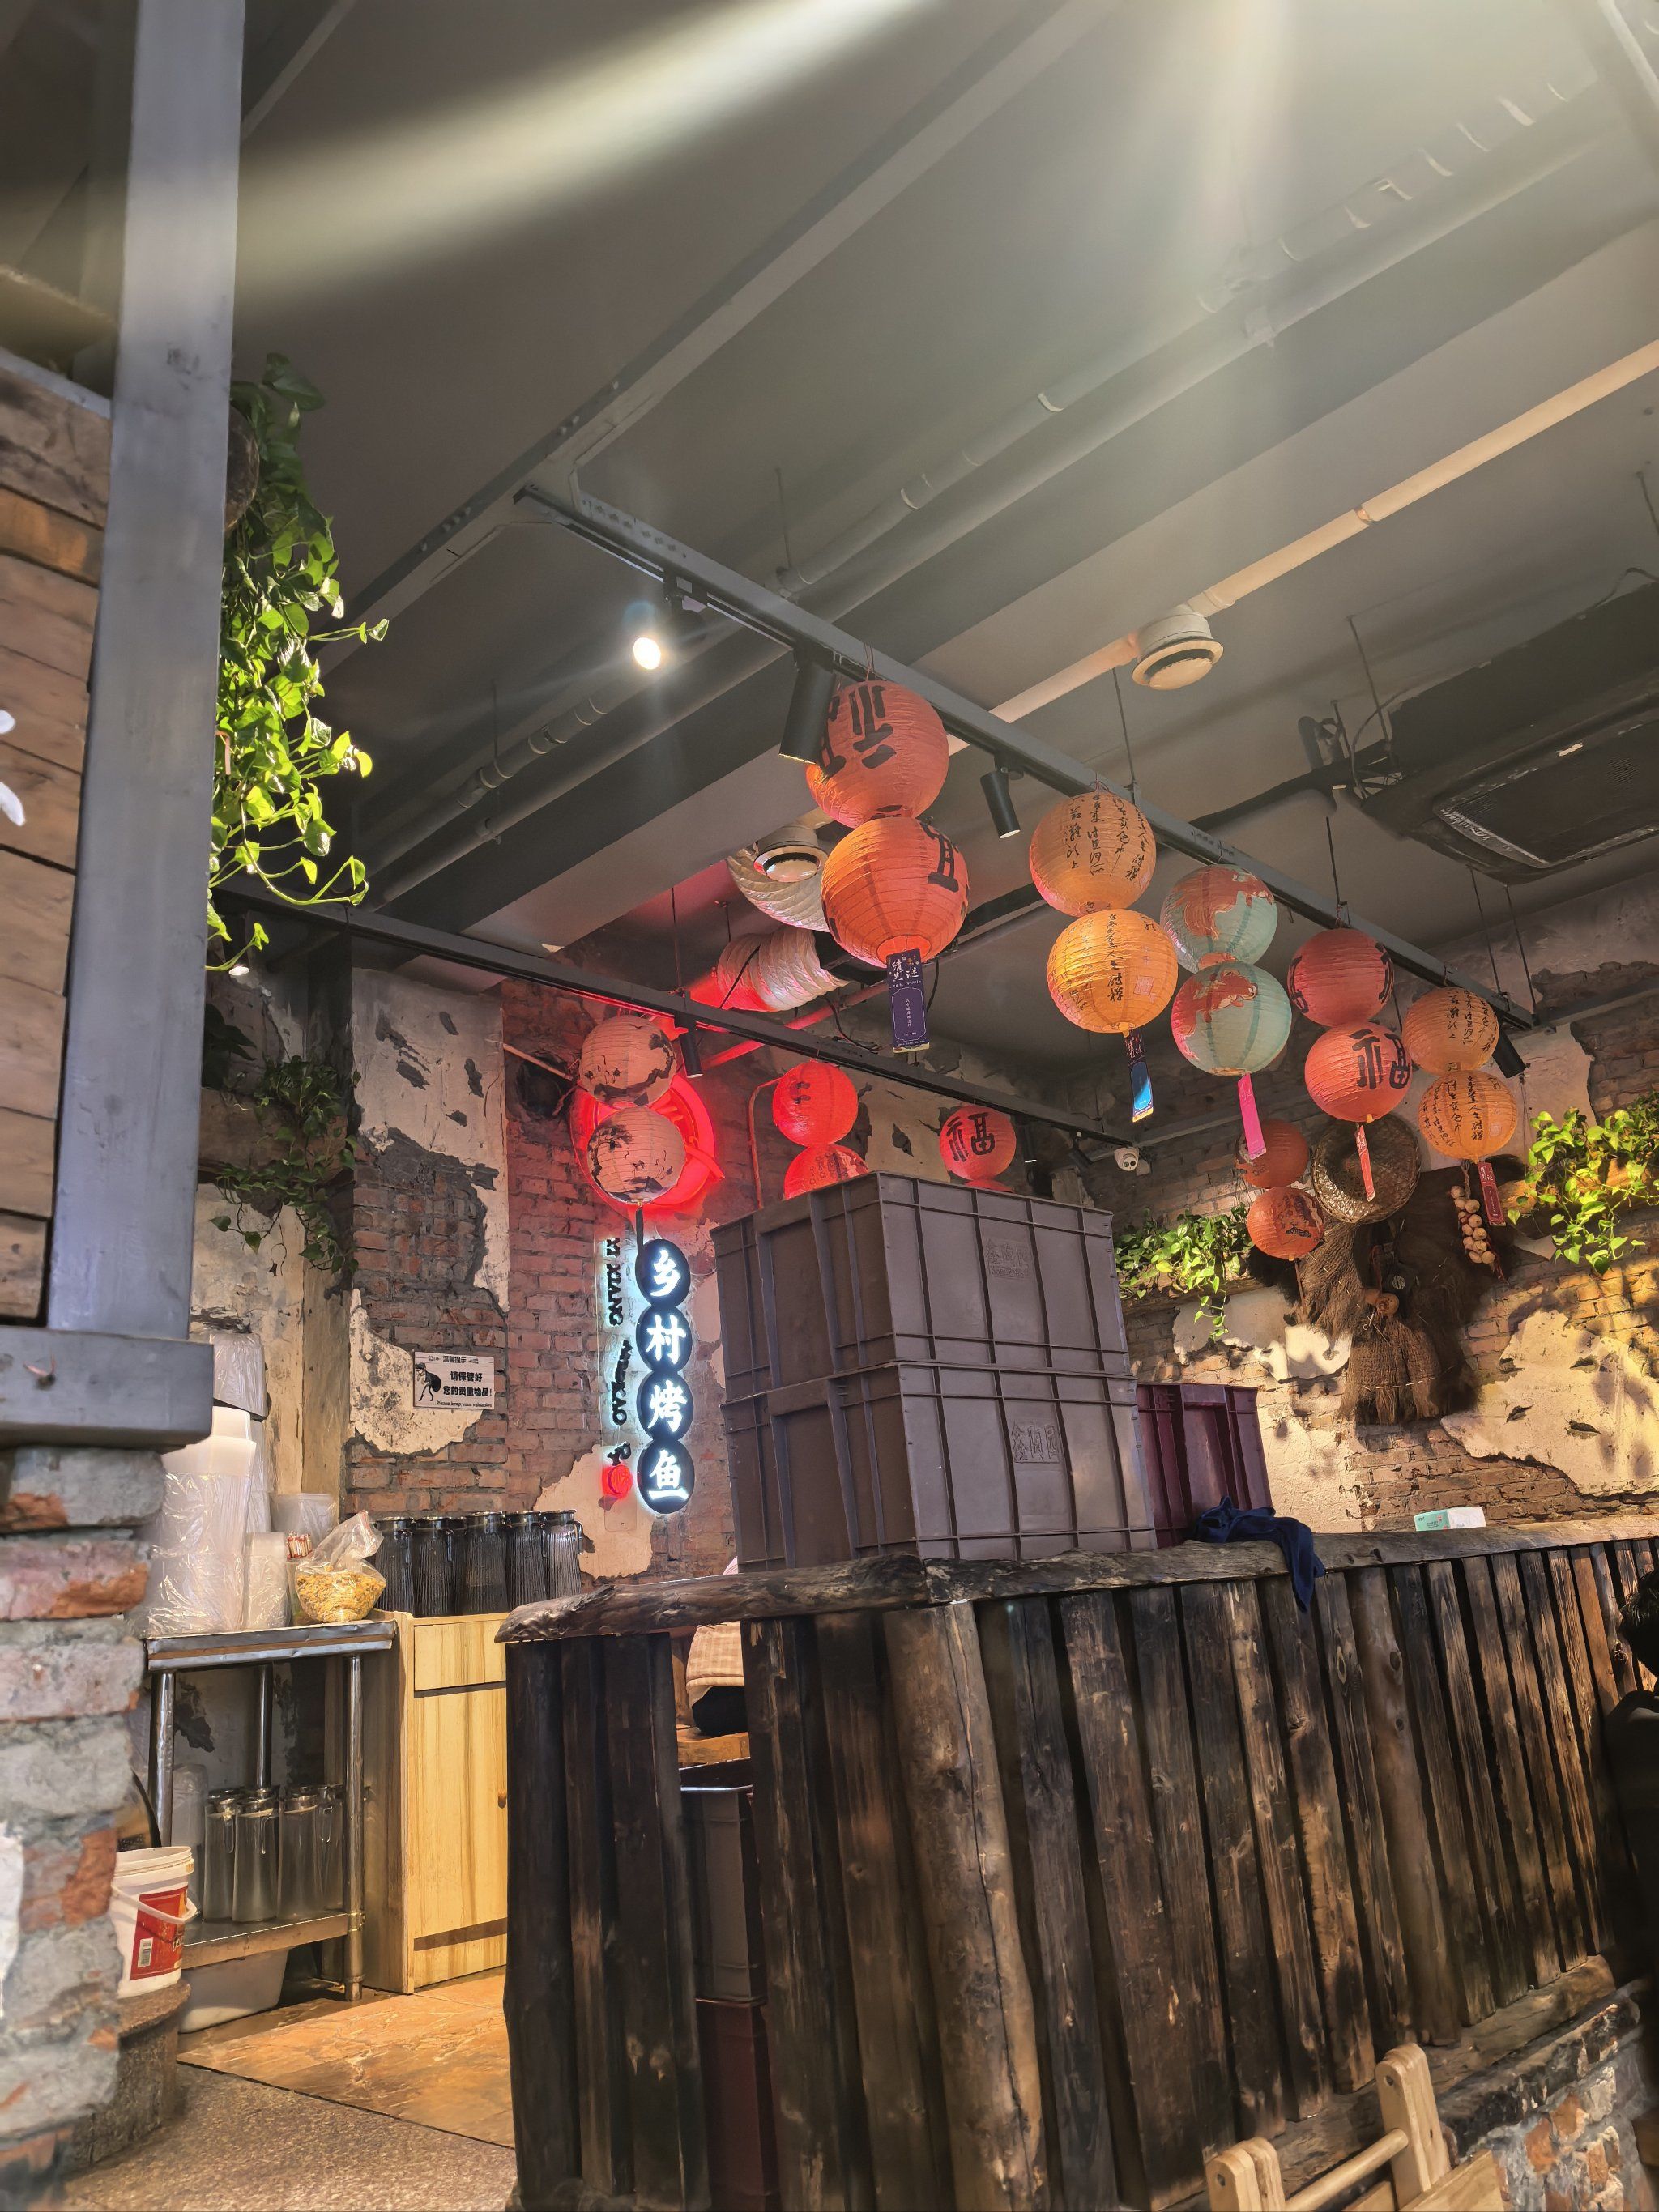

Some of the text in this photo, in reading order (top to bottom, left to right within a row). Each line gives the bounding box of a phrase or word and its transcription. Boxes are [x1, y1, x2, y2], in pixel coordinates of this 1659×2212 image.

[443, 1355, 467, 1363] 温馨提示
[450, 1371, 483, 1382] 请保管好
[646, 1249, 690, 1501] 乡村烤鱼
